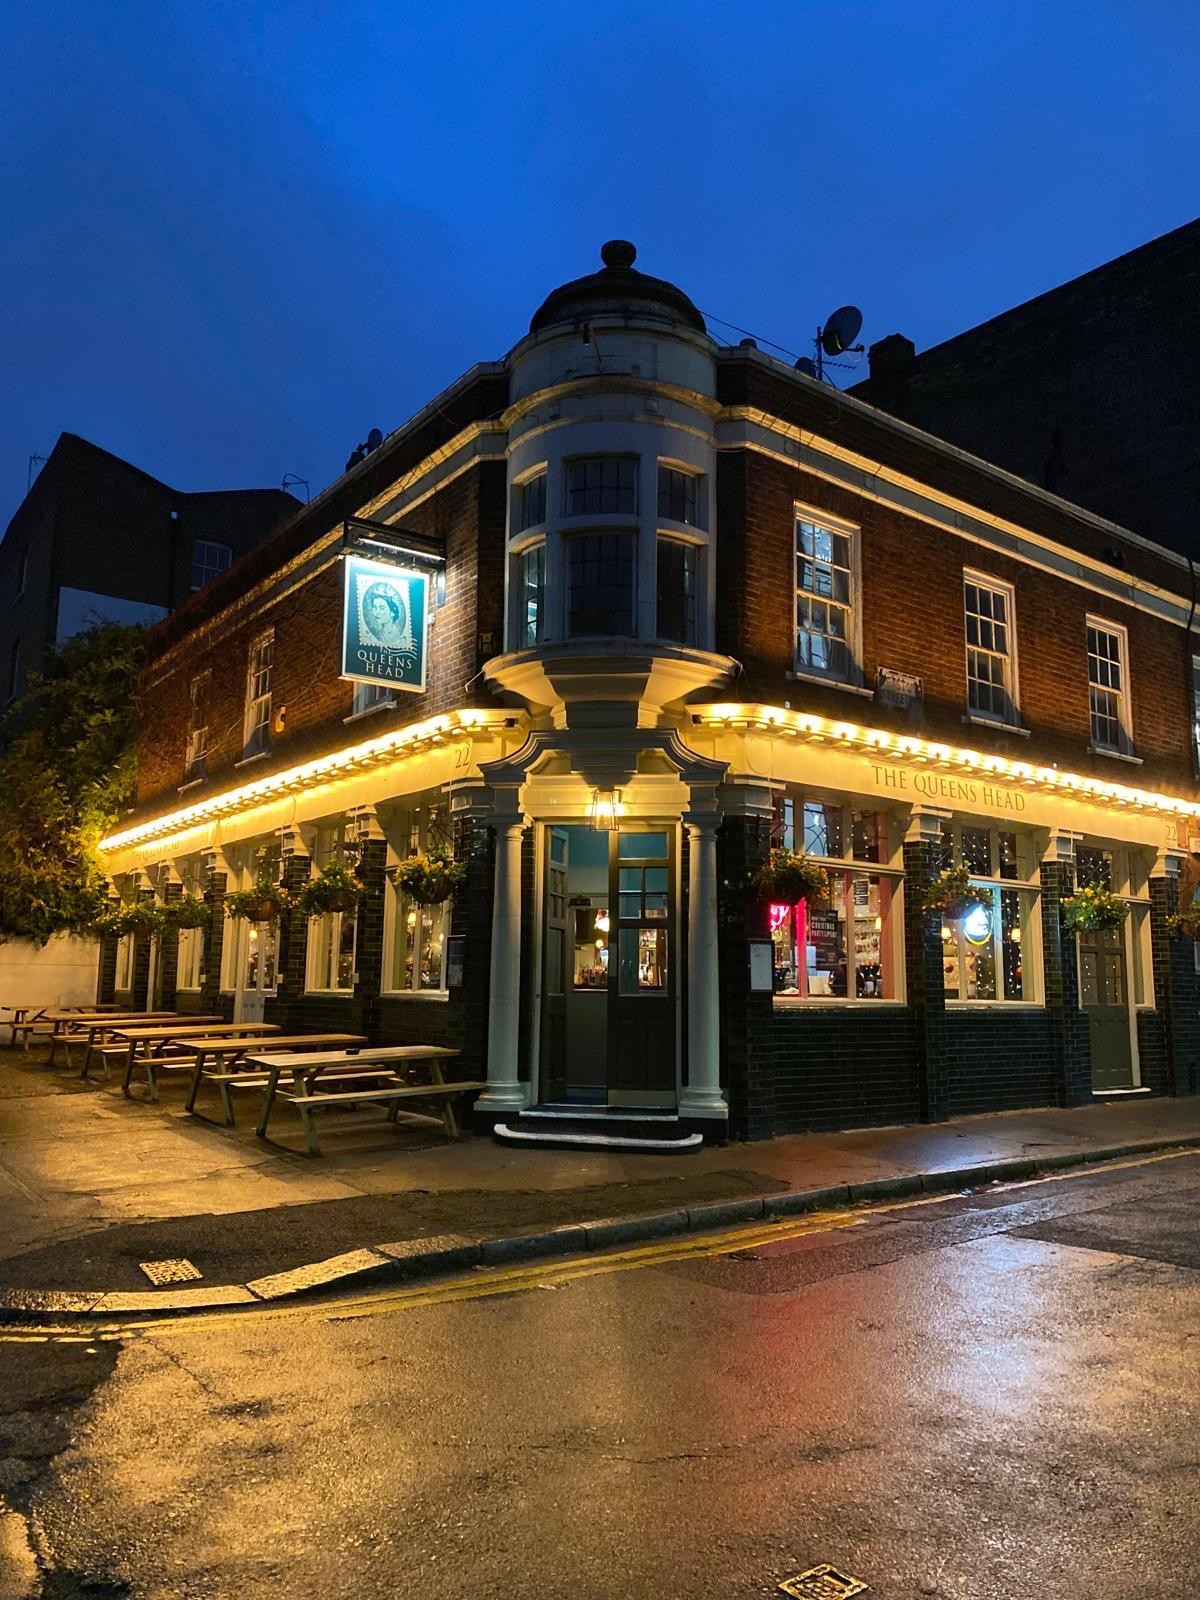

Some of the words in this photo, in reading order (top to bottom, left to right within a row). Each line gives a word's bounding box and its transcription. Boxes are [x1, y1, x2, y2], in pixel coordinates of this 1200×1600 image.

[357, 650, 412, 669] QUEENS
[366, 663, 404, 678] HEAD
[456, 748, 470, 768] 22
[872, 765, 907, 789] THE
[914, 774, 977, 802] QUEENS
[983, 787, 1025, 811] HEAD
[1166, 825, 1176, 841] 22
